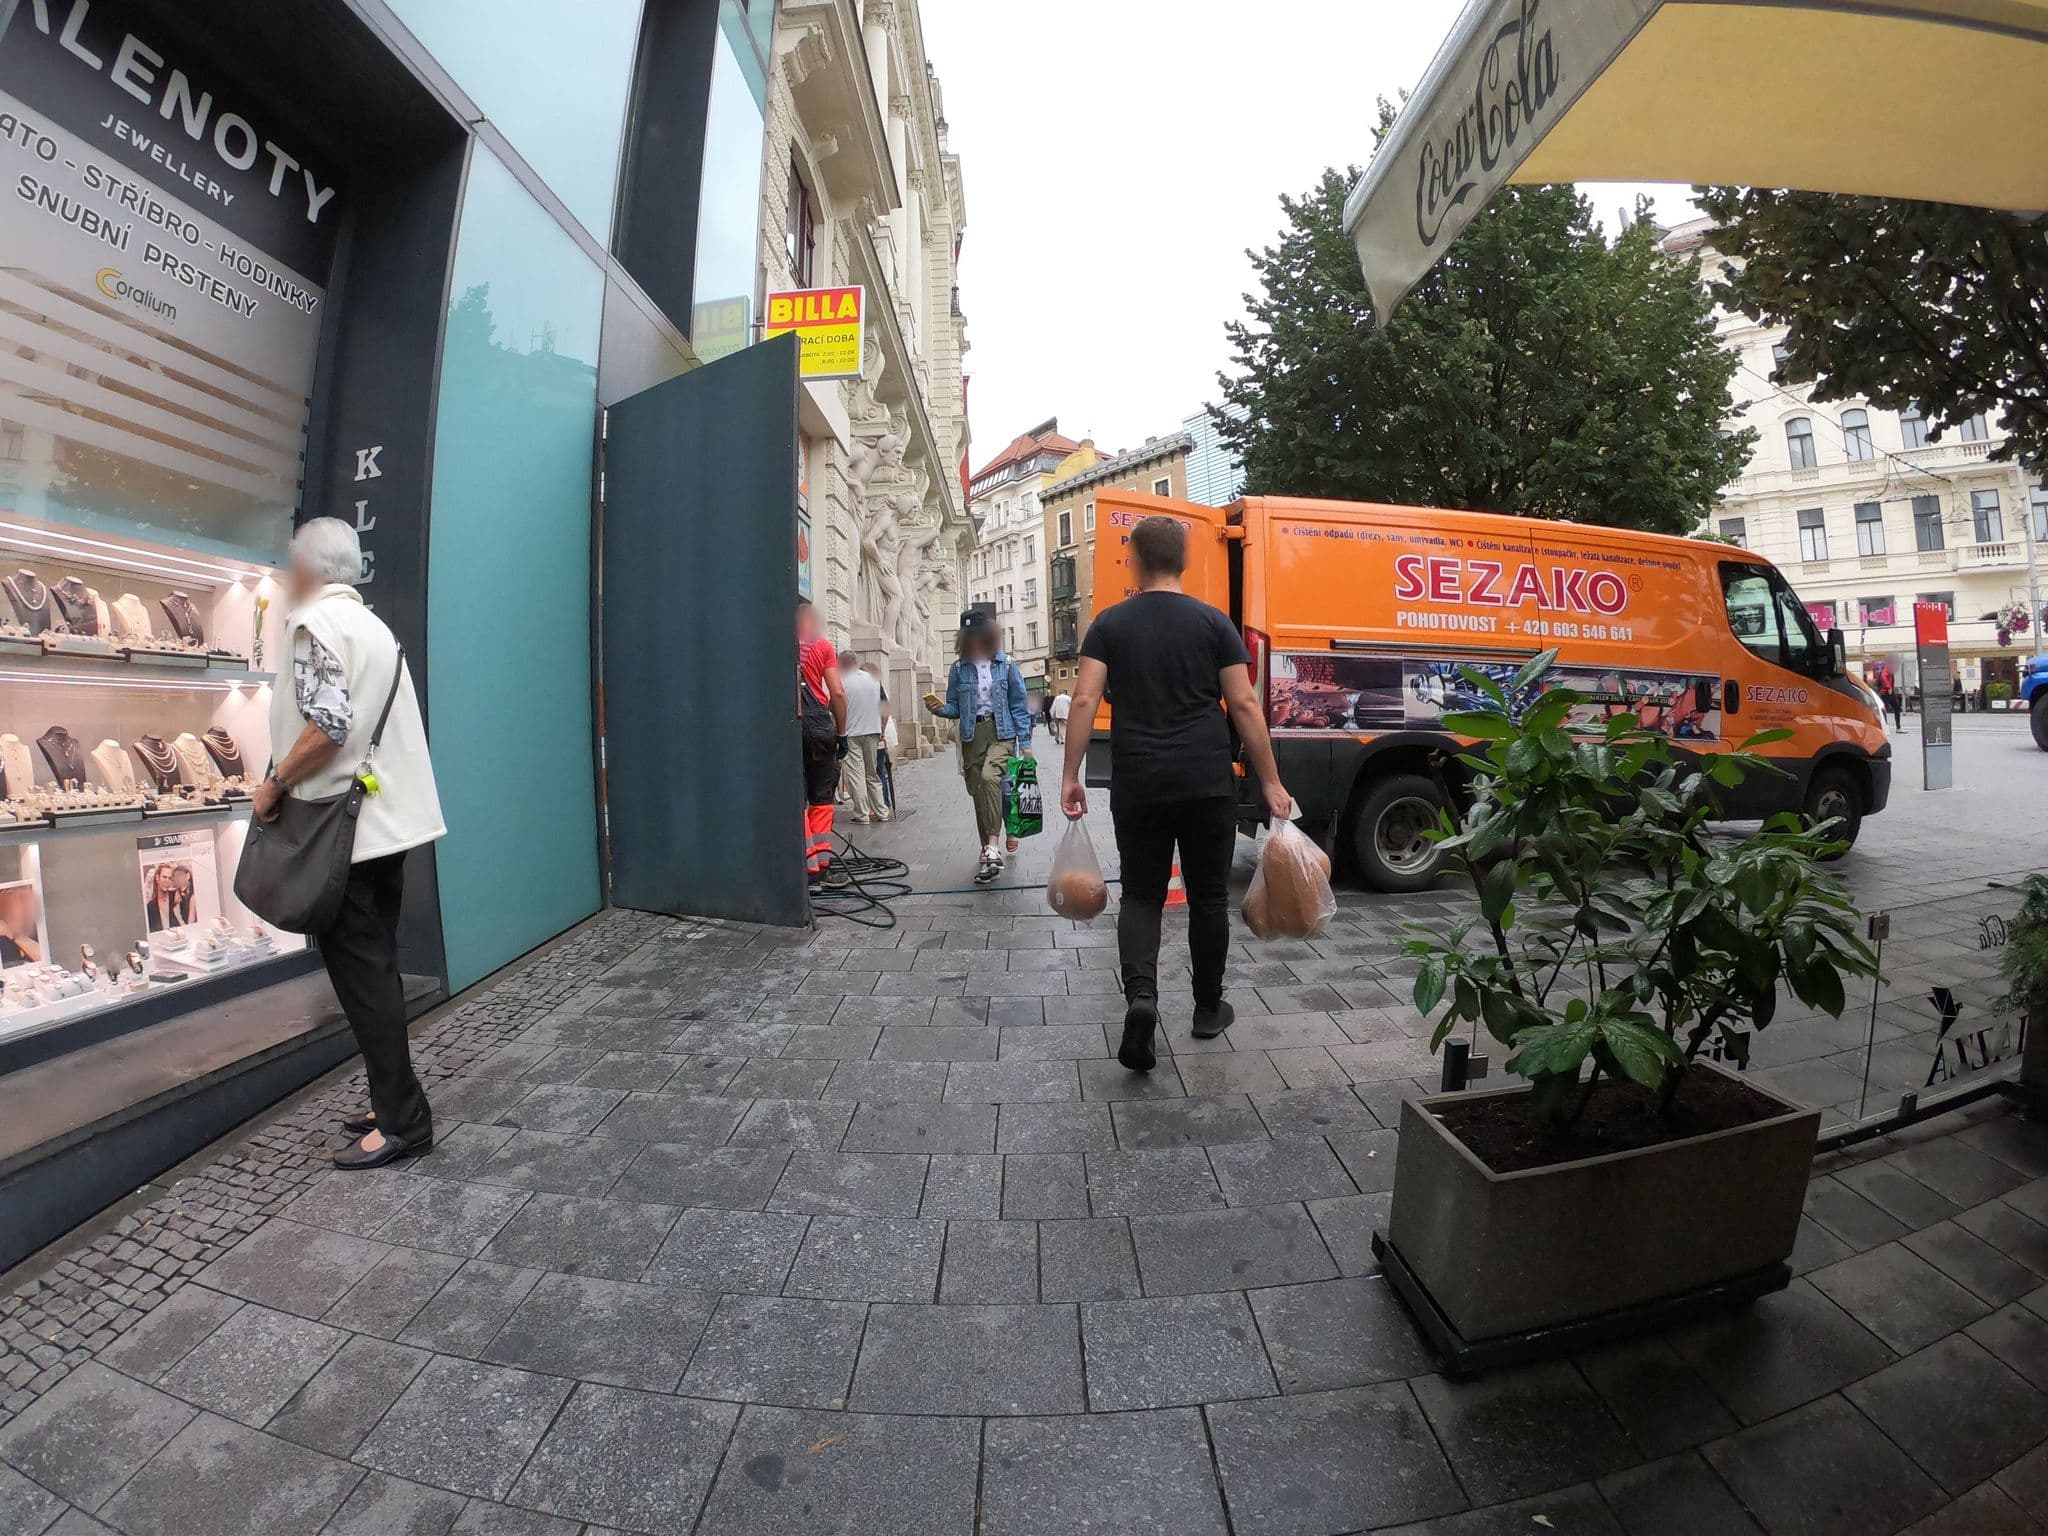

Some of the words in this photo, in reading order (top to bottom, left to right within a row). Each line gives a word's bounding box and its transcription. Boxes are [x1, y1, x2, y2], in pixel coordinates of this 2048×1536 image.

[1416, 0, 1559, 246] Coca-Cola
[100, 113, 235, 207] JEWELLERY
[16, 174, 133, 251] SNUBNÍ
[143, 242, 259, 319] PRSTENY
[83, 164, 200, 246] STŘÍBRO
[219, 243, 318, 315] HODINKY
[95, 267, 178, 320] Coralium
[769, 293, 858, 324] BILLA
[826, 334, 855, 344] DOBA
[1394, 553, 1628, 616] SEZAKO
[1396, 610, 1498, 633] POHOTOVOST
[1553, 622, 1579, 639] 603
[1582, 623, 1607, 641] 546
[1610, 625, 1633, 642] 641
[1746, 684, 1809, 705] SEZAKO
